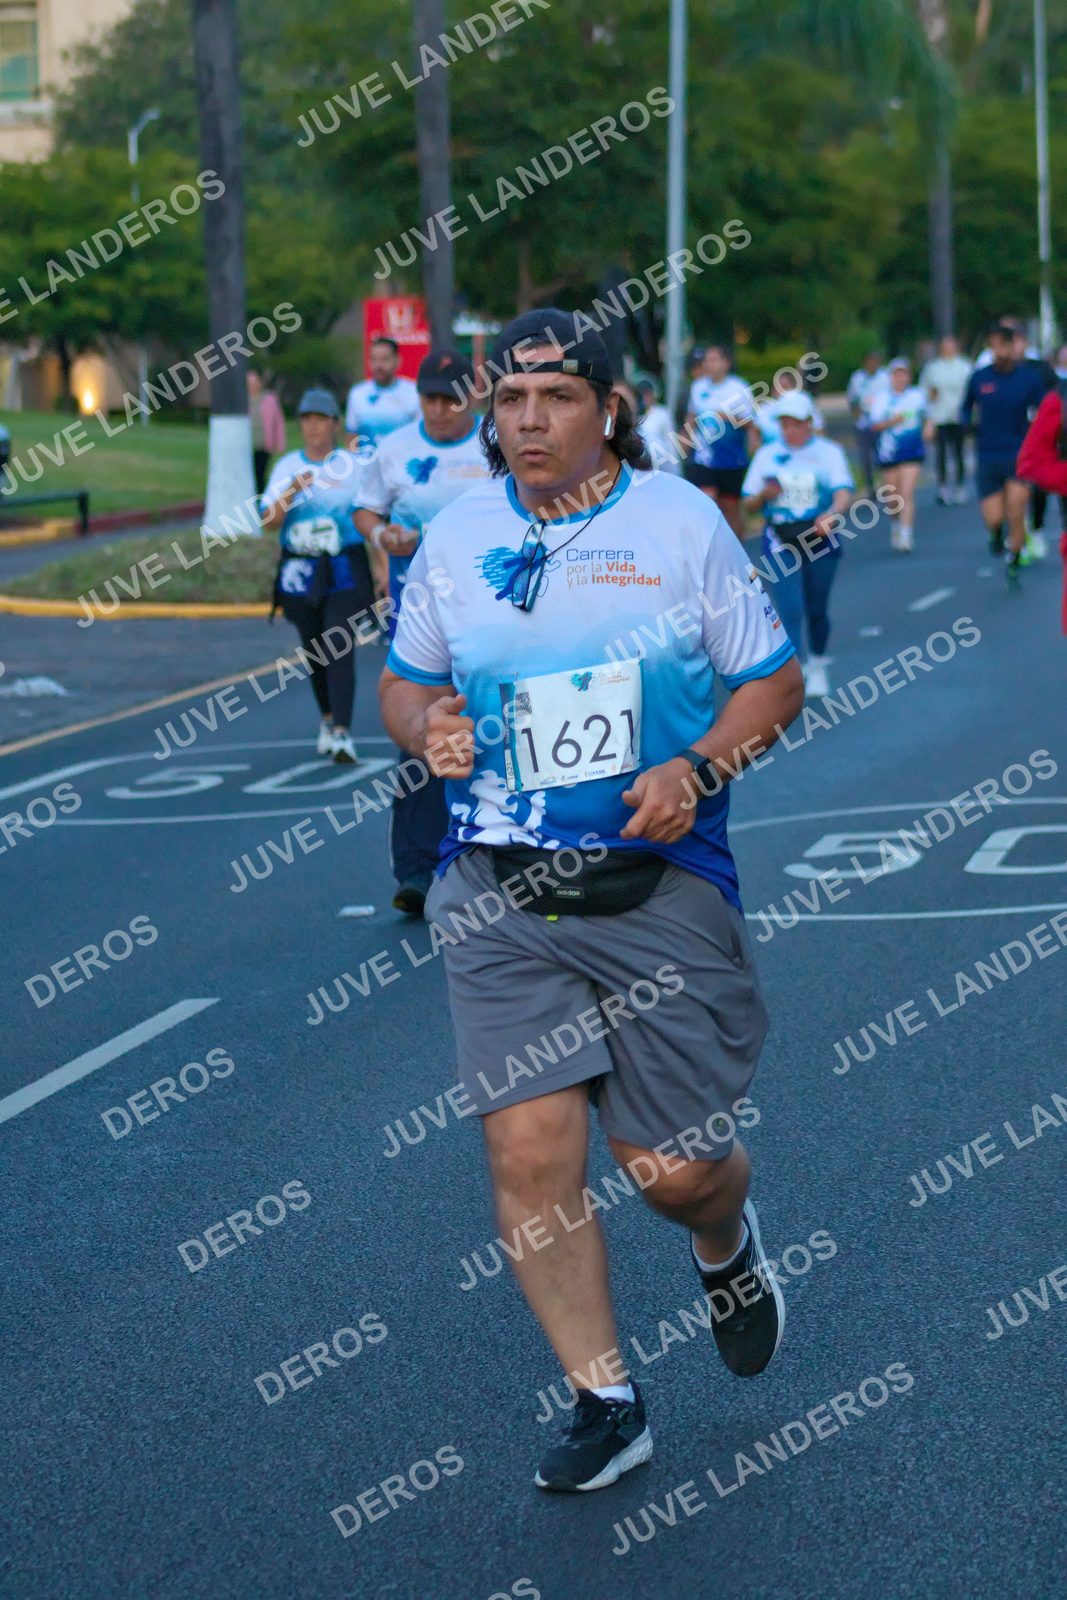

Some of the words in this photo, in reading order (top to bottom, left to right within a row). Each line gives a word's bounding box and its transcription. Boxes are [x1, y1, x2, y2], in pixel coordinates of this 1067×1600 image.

[566, 549, 634, 562] Carrera
[567, 564, 587, 577] por
[591, 562, 601, 573] la
[606, 562, 636, 573] Vida
[567, 578, 573, 589] y
[577, 575, 588, 585] la
[591, 574, 661, 587] Integridad
[521, 709, 635, 773] 1621
